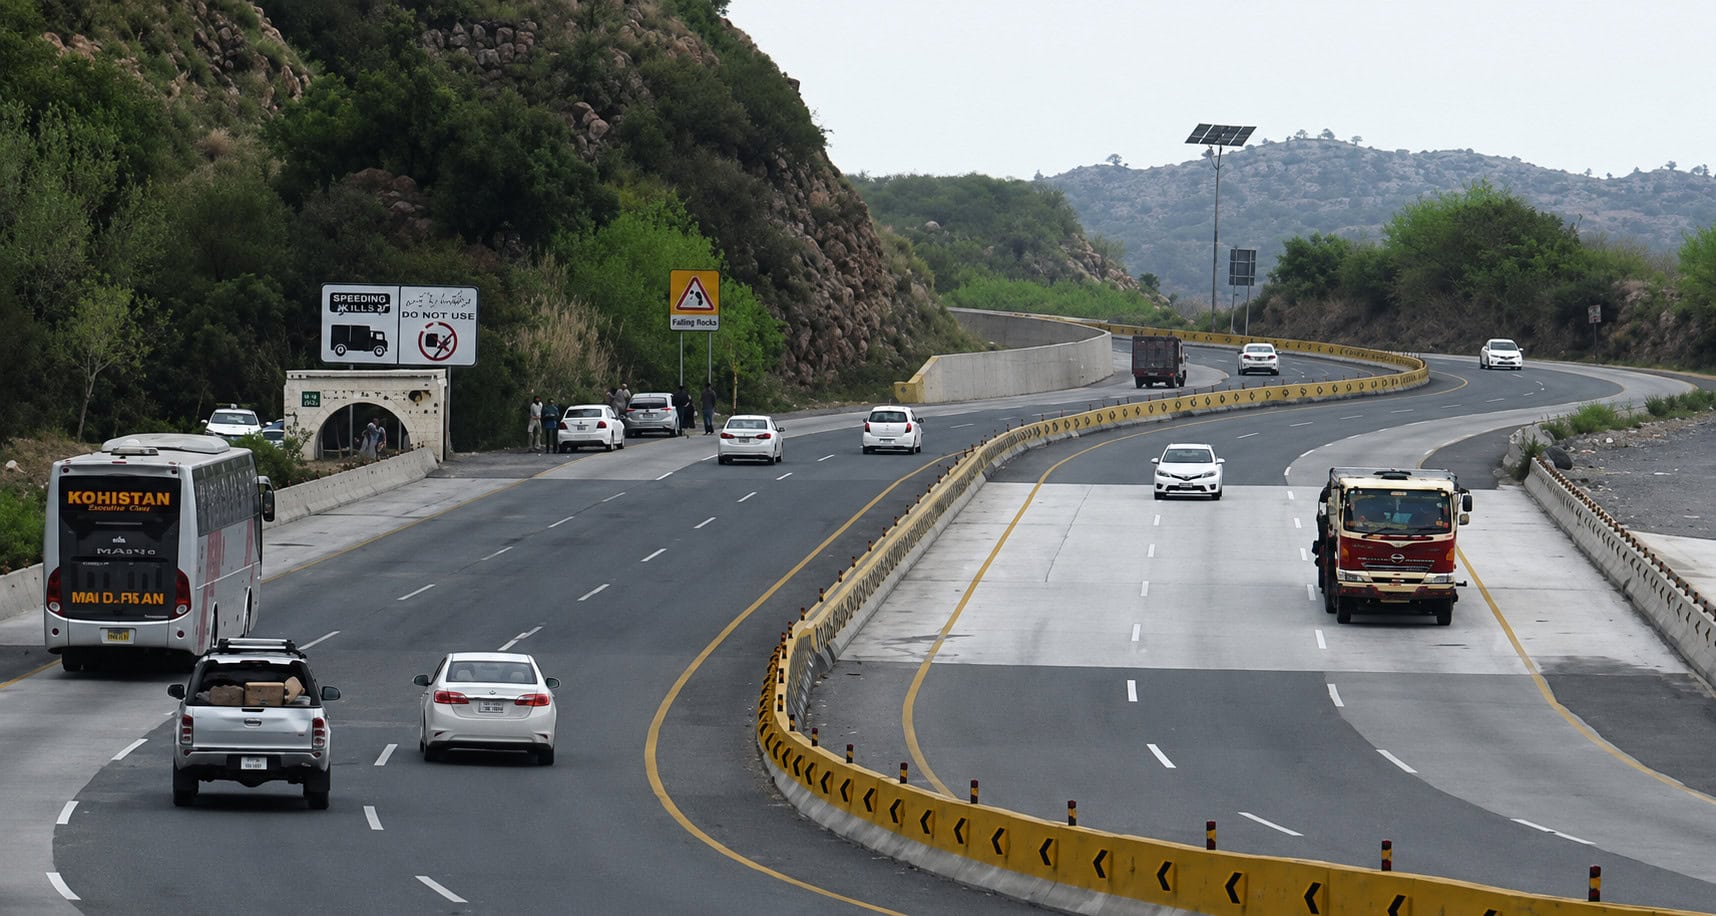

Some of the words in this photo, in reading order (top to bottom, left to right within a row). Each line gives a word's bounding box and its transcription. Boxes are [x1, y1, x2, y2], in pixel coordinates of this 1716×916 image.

[333, 294, 386, 303] SPEEDING
[422, 311, 448, 319] NOT
[451, 312, 475, 320] USE
[672, 319, 695, 328] Falling
[697, 319, 717, 327] Rocks
[68, 491, 171, 505] KOHISTAN
